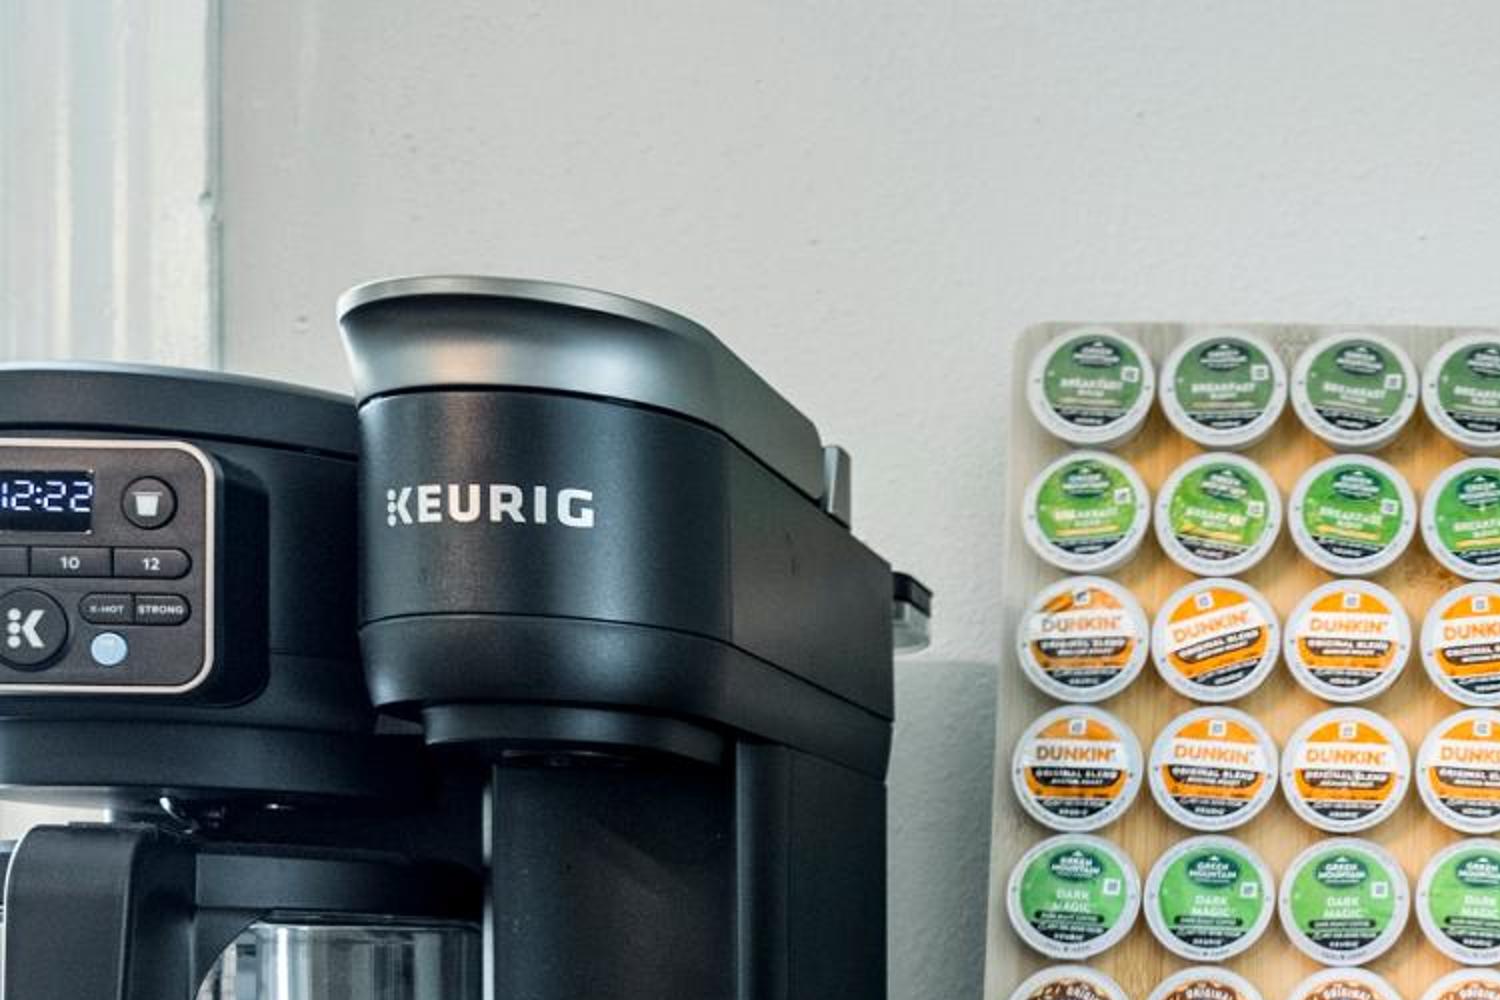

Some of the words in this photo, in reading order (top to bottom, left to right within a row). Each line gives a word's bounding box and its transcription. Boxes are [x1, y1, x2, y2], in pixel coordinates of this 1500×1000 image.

[2, 480, 93, 513] 12:22
[387, 484, 596, 528] KEURIG
[60, 556, 80, 569] 10
[142, 558, 160, 571] 12
[138, 604, 184, 615] STRONG
